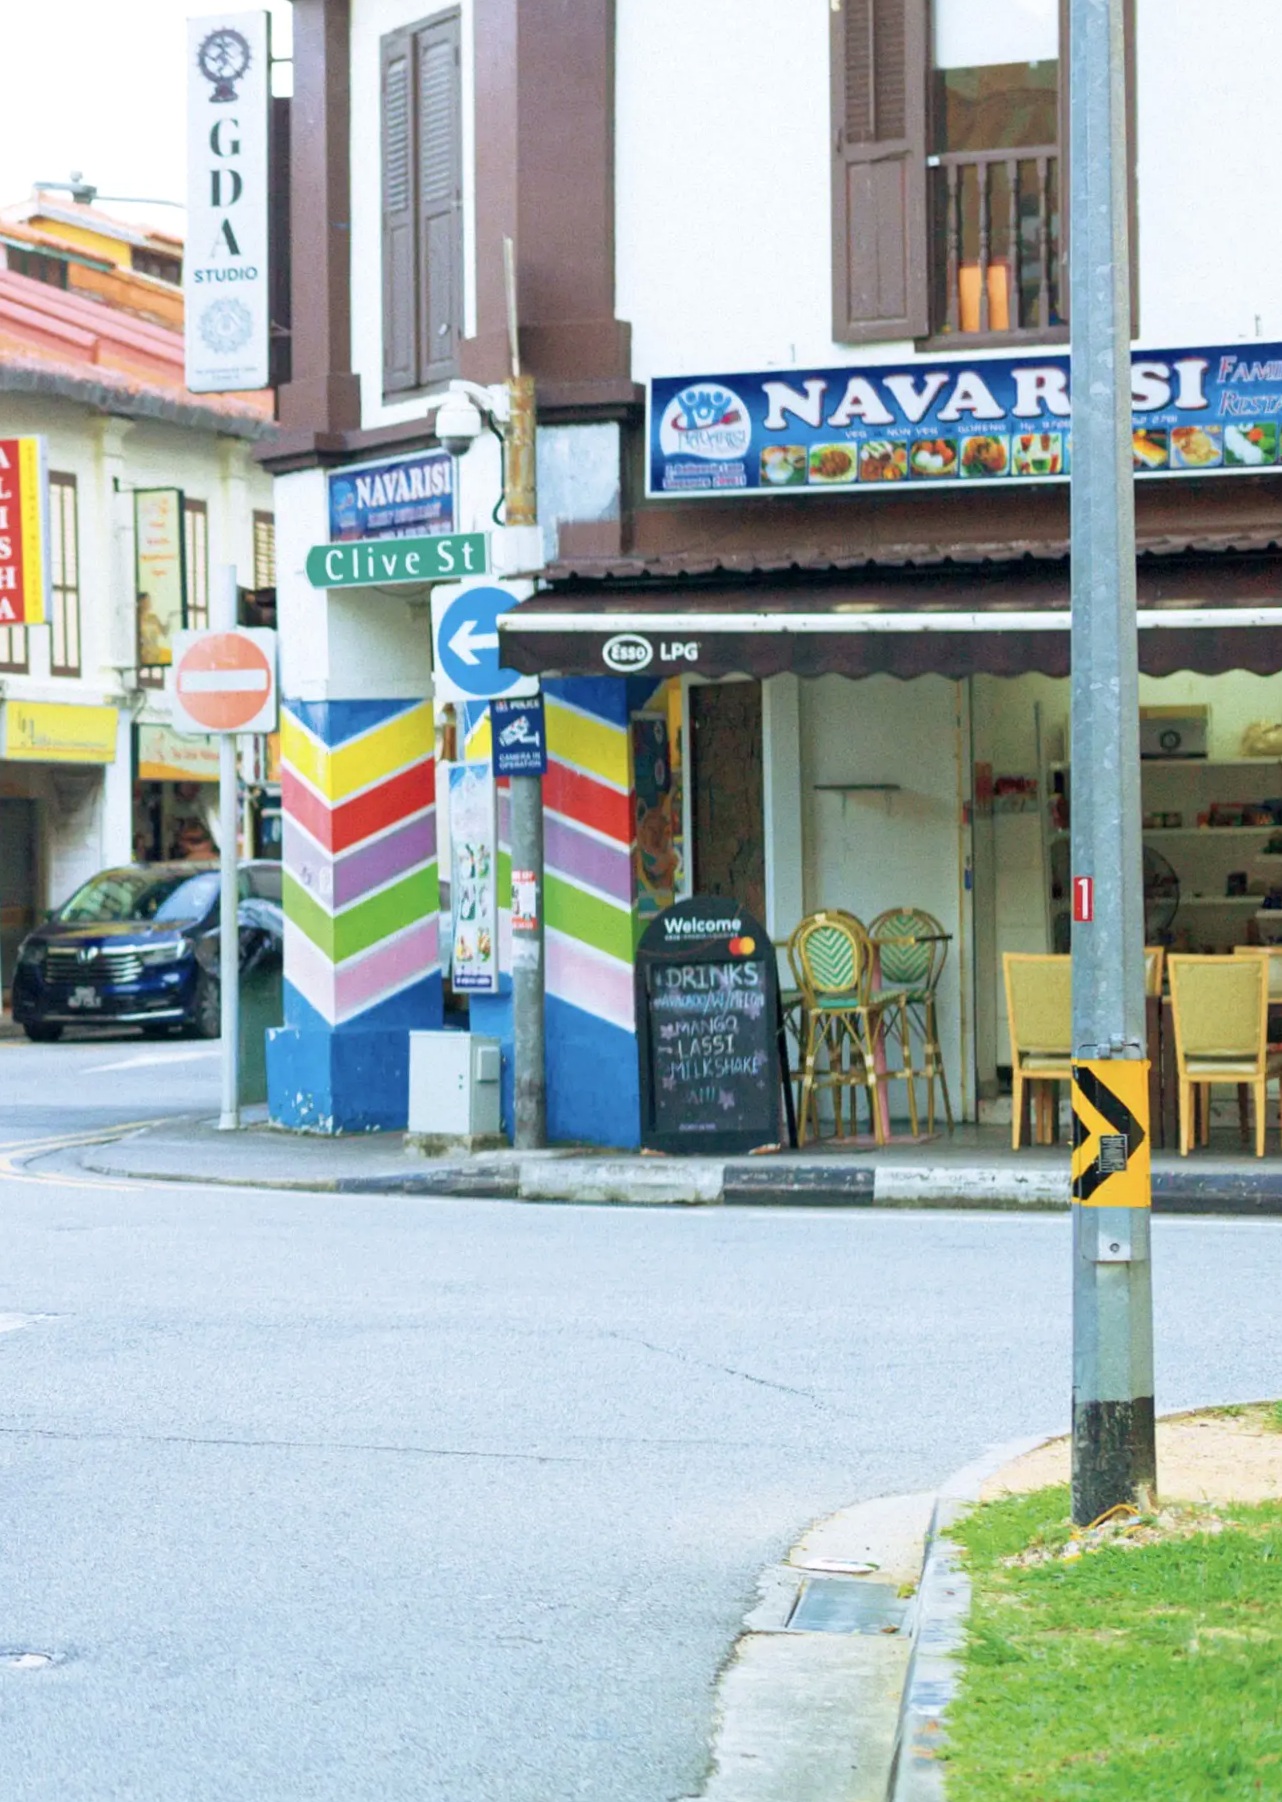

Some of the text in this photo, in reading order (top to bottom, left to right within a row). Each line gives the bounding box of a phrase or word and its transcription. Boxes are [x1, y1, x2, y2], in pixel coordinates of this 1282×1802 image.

[209, 117, 243, 258] GDA
[193, 266, 258, 283] STUDIO
[762, 356, 1210, 430] NAVARSI
[356, 461, 452, 509] NAVARISI
[325, 540, 474, 581] Clive St
[610, 641, 698, 661] Esso LPG
[499, 751, 541, 761] CAMERA IN
[499, 760, 542, 770] OPERATION
[1077, 878, 1089, 920] 1
[664, 917, 742, 934] Welcome
[665, 961, 759, 989] DRINKS
[675, 1015, 737, 1036] MANGO
[678, 1034, 734, 1060] LASSI
